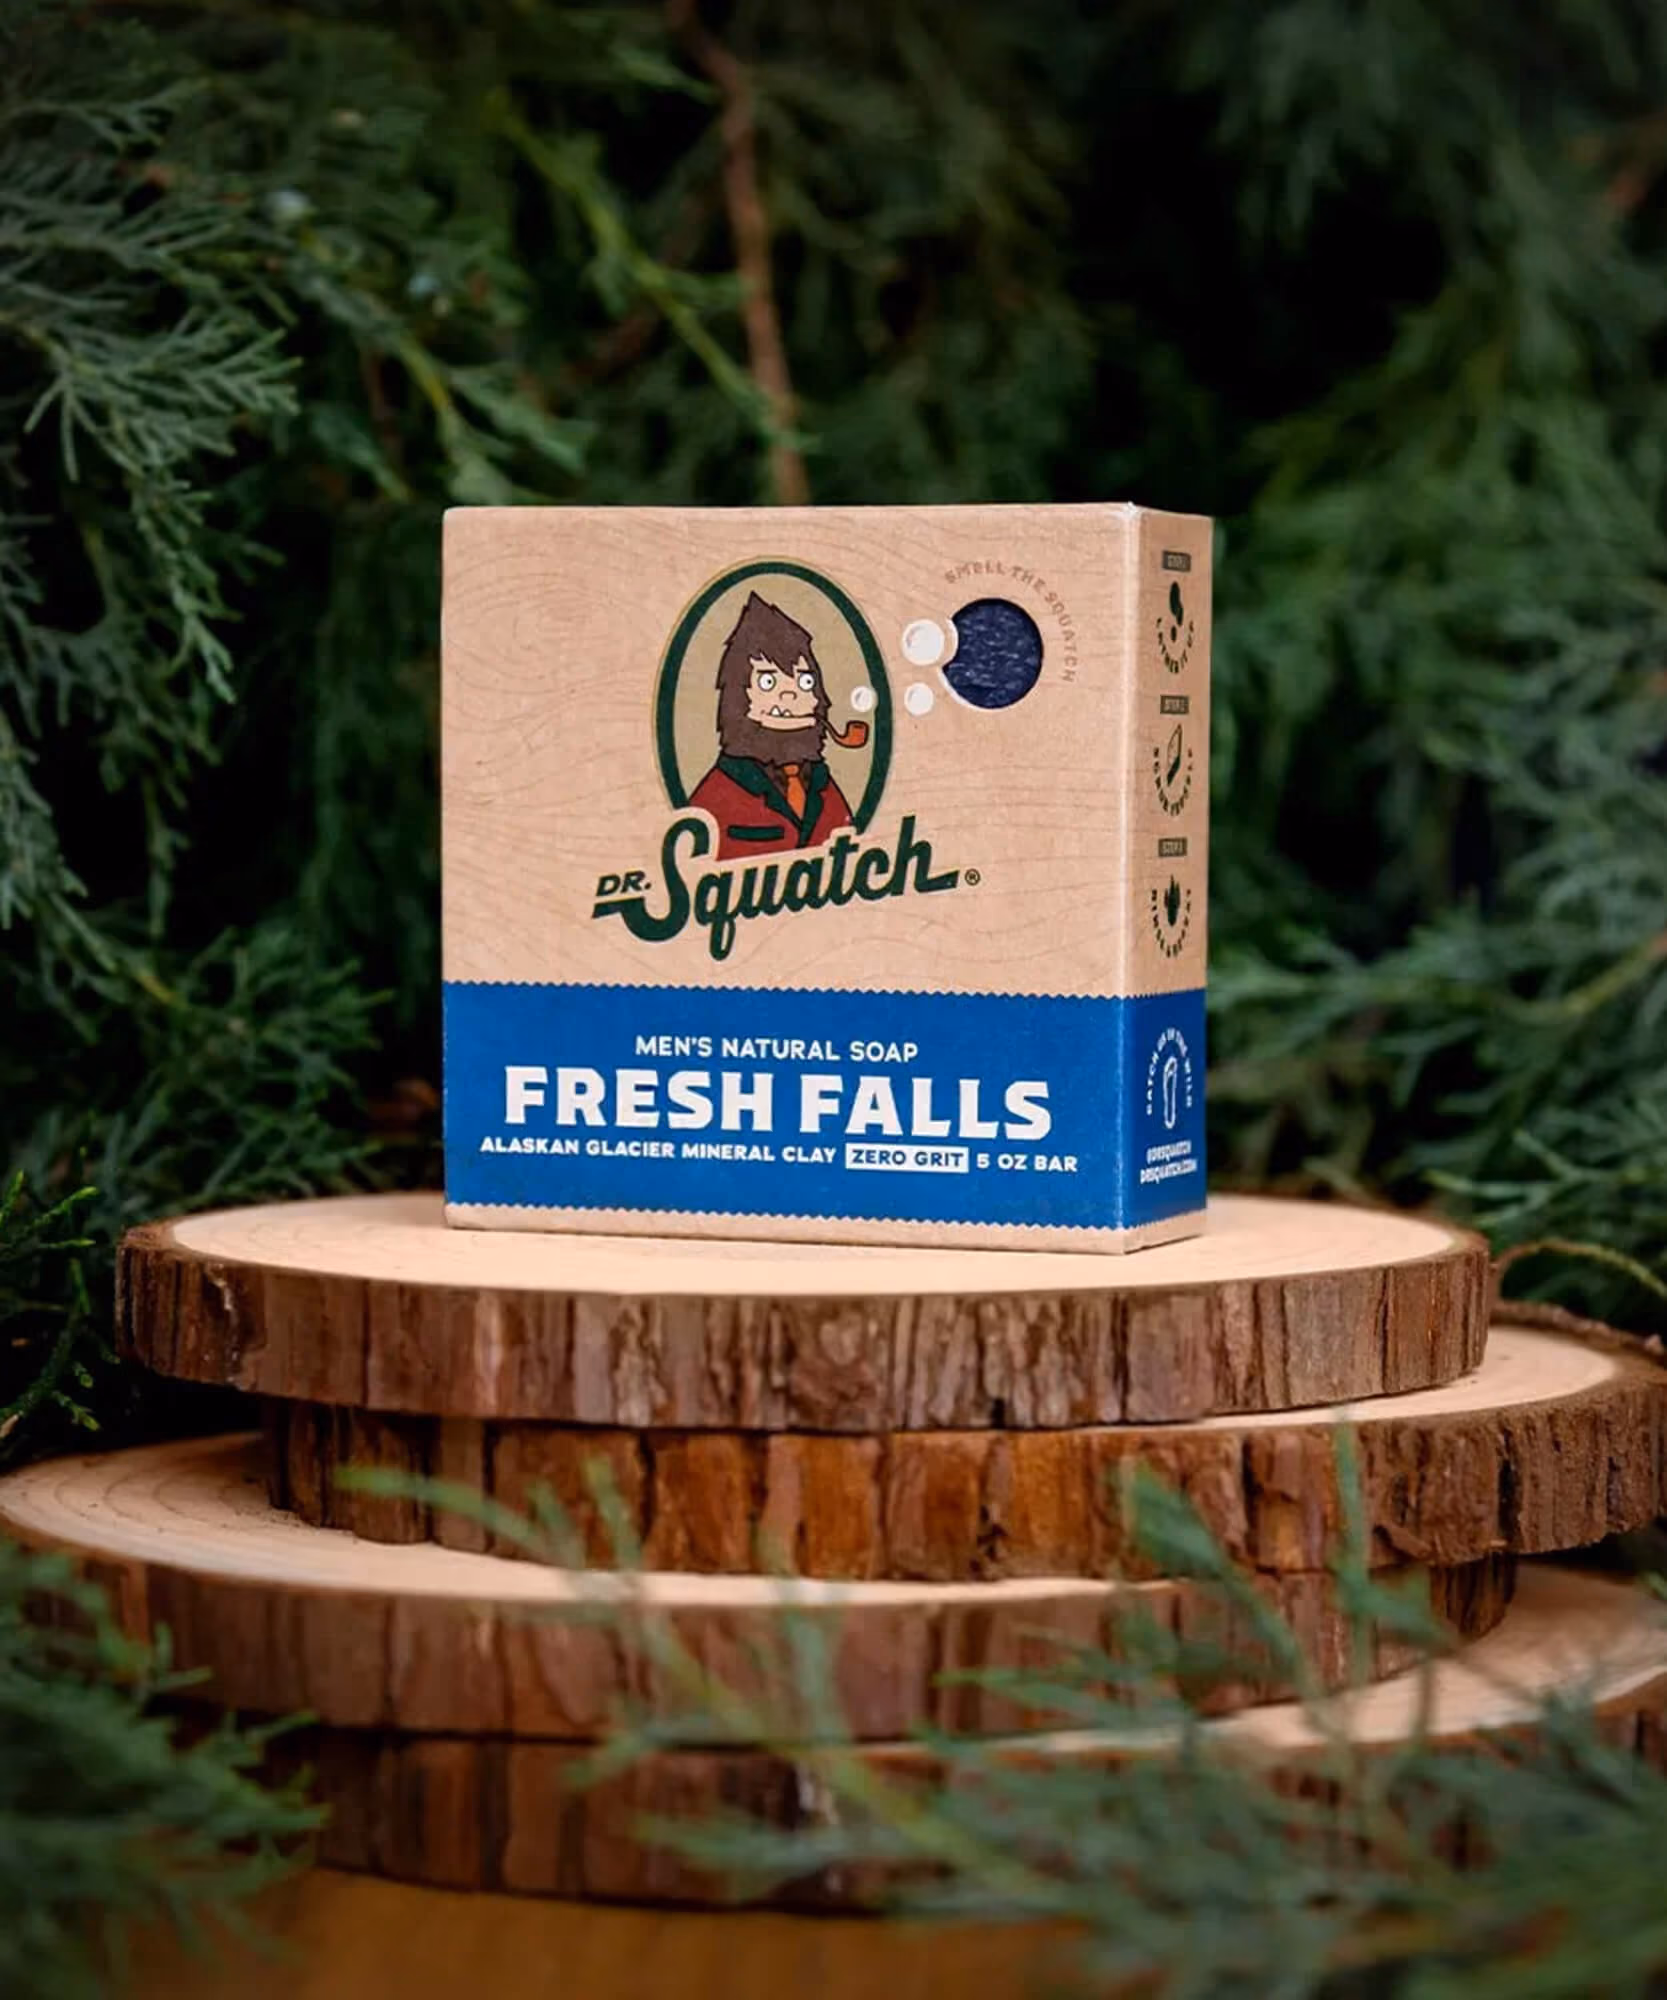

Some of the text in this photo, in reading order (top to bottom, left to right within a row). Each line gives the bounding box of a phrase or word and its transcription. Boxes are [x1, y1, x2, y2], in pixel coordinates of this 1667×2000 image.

[944, 560, 1078, 684] SMELL THE SQUATCH
[591, 815, 961, 962] Squatch
[596, 870, 652, 897] DR.
[635, 1035, 919, 1063] MEN'S NATURAL SOAP
[504, 1065, 1053, 1141] FRESH FALLS
[480, 1136, 1078, 1173] ALASKAN GLACIER MINERAL CLAY ZERO GRIT 5 OZ BAR
